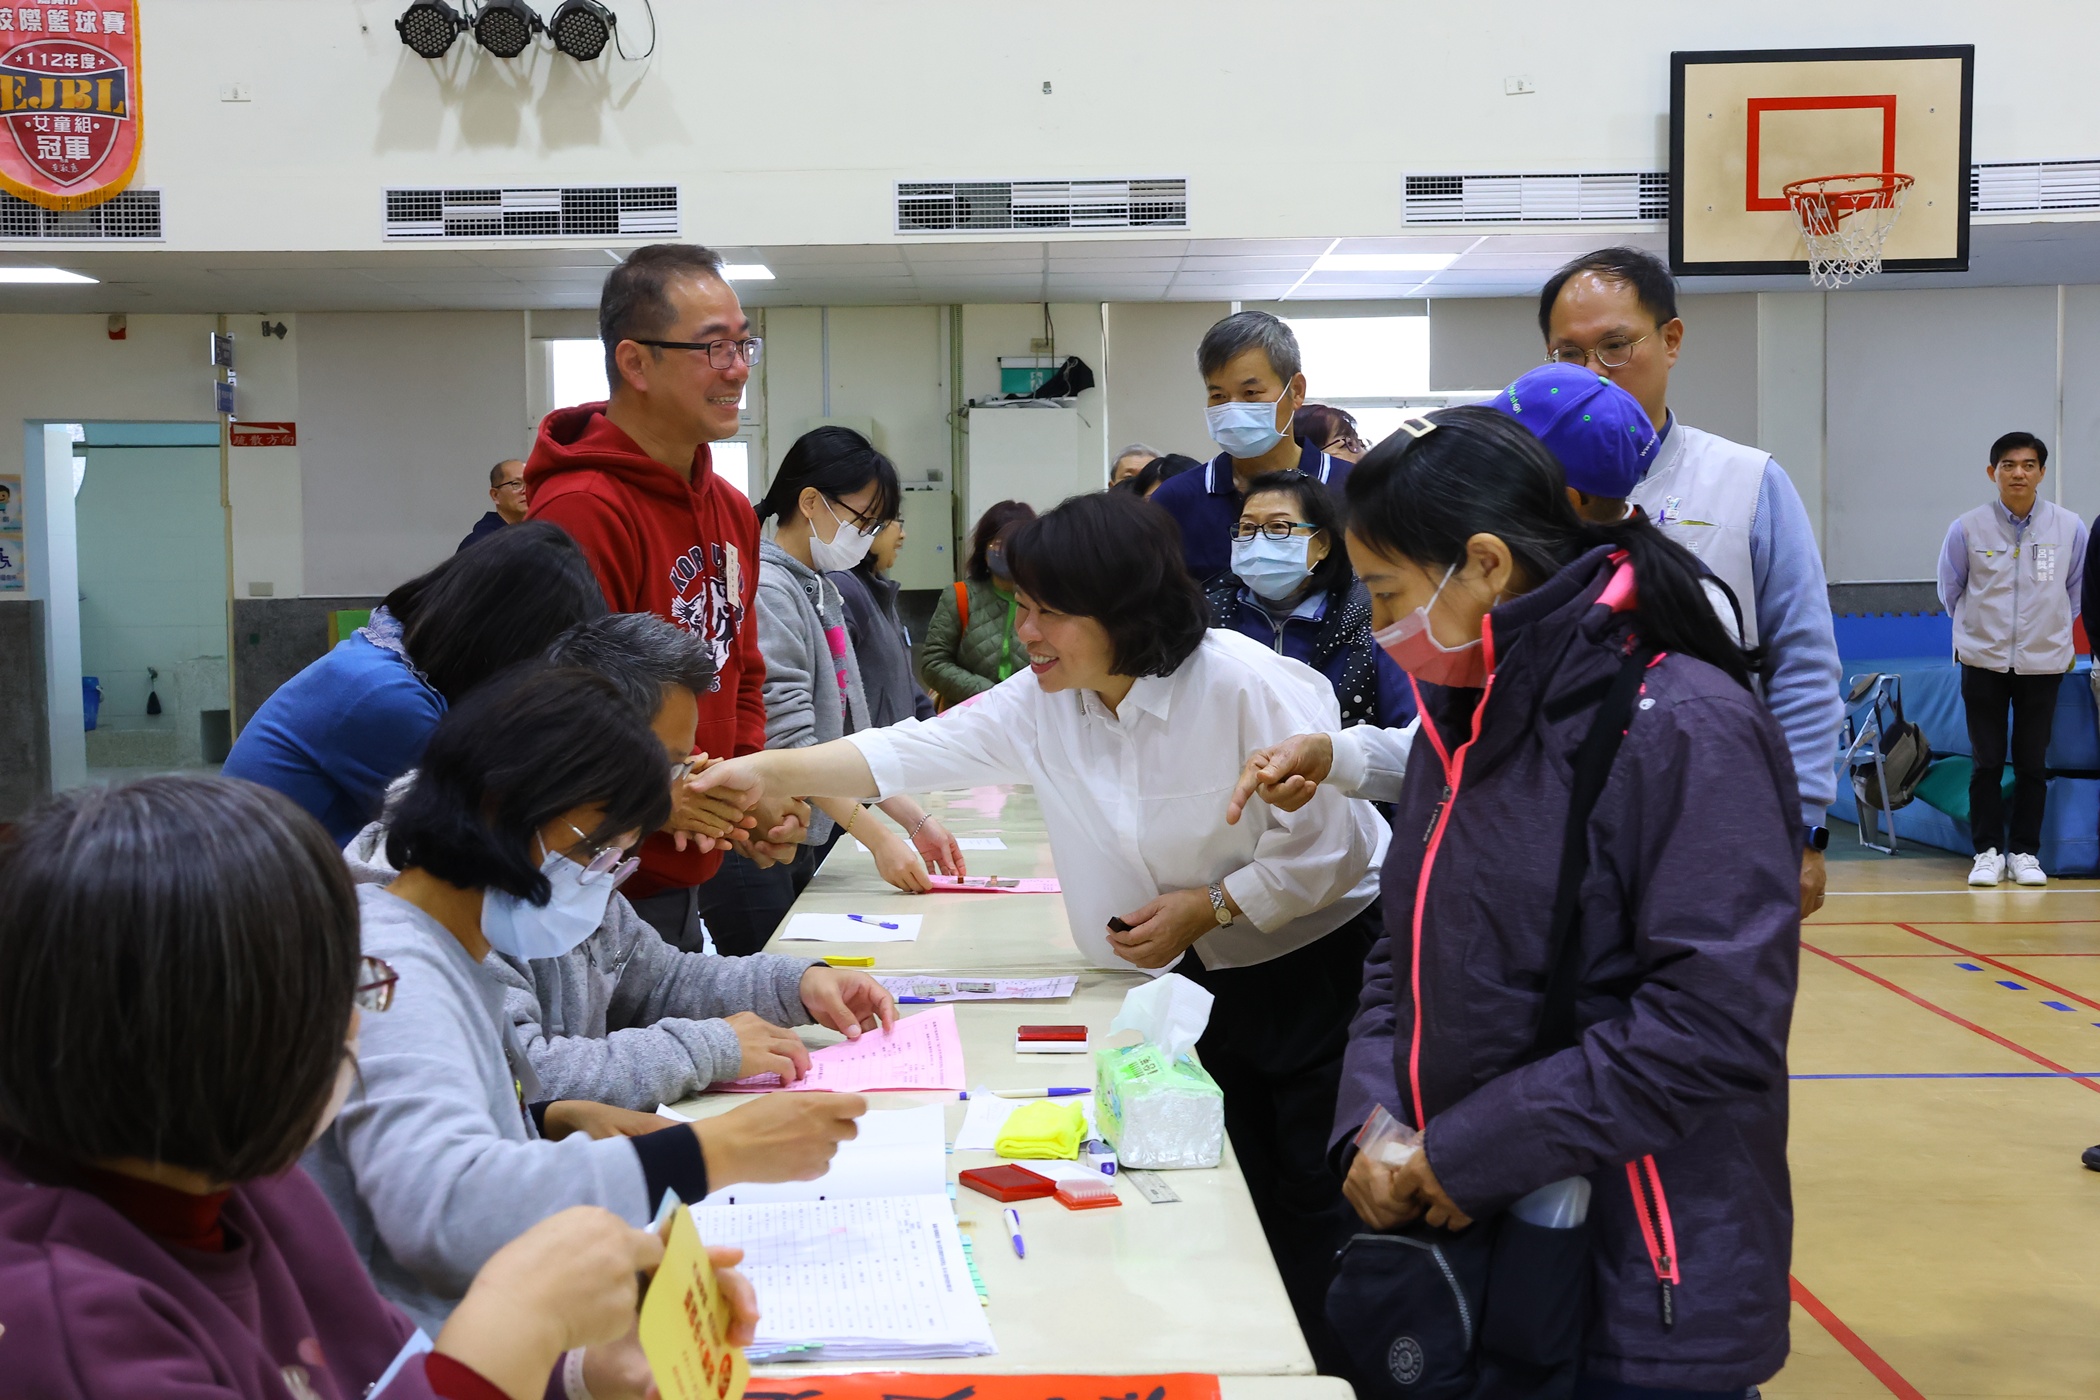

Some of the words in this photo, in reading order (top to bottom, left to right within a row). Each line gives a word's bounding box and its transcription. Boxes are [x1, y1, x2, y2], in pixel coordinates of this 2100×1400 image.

[0, 8, 126, 34] 校際籃球賽
[27, 52, 96, 69] 112年度
[0, 74, 125, 114] EJBL
[32, 115, 92, 133] 女童組
[36, 135, 91, 160] 冠軍
[232, 434, 295, 446] 疏散方向
